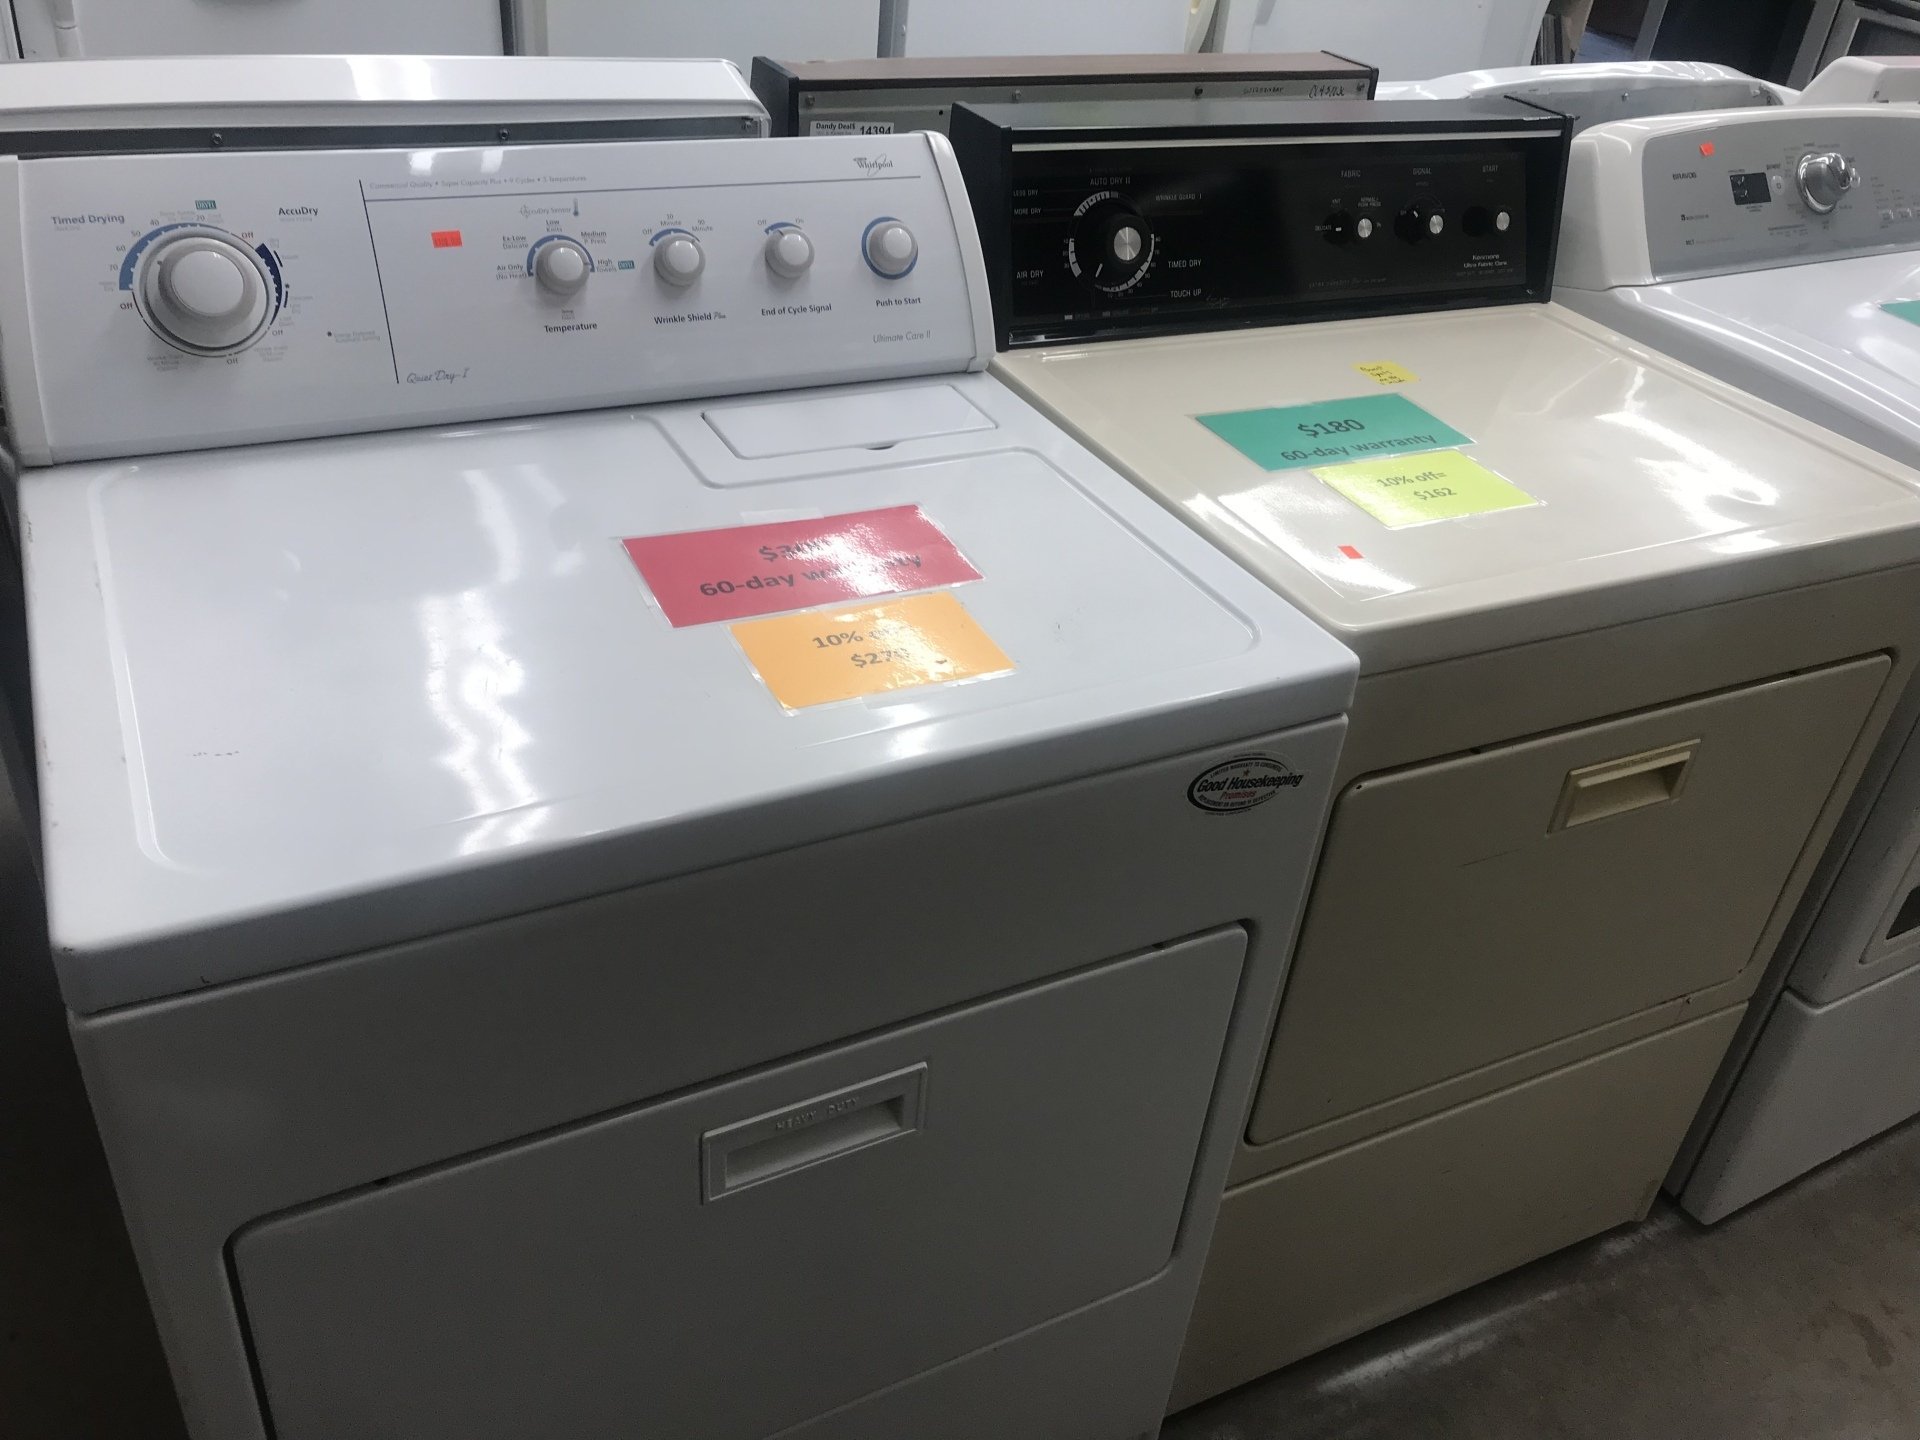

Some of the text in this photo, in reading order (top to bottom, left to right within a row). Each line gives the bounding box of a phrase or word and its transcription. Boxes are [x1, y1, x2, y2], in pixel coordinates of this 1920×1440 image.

[816, 122, 837, 130] Dandy
[859, 126, 891, 135] 14394
[853, 157, 894, 171] Whirlpool
[410, 181, 433, 189] Quality
[461, 178, 488, 187] Capacity
[548, 175, 587, 183] Temperatures
[1089, 178, 1108, 186] AUTO
[1110, 177, 1123, 185] DRY
[278, 206, 319, 217] AccuDry
[1014, 207, 1042, 216] MORE DRY
[51, 214, 125, 225] Timed Drying
[242, 231, 254, 239] Off
[581, 230, 607, 238] Medium
[1472, 253, 1500, 261] Kenmore
[507, 264, 524, 272] Only
[597, 259, 613, 267] High
[1168, 259, 1202, 269] TIMED DRY
[1016, 270, 1044, 279] AIR DRY
[1170, 288, 1202, 298] TOUCH UP
[120, 301, 133, 310] Off
[876, 296, 921, 308] Push to Start
[761, 303, 832, 317] End of Cycle Signal
[654, 312, 685, 325] Wrinkle
[687, 311, 712, 322] Shield
[272, 329, 284, 337] Off
[544, 322, 598, 334] Temperature
[873, 332, 904, 344] Ultimate
[906, 331, 925, 341] Care
[227, 357, 239, 365] Off
[406, 372, 433, 384] Quiet
[1297, 418, 1366, 439] $180
[1280, 433, 1438, 462] 60-day warranty
[1376, 471, 1447, 488] 10% off=
[1413, 487, 1458, 502] $162
[699, 572, 796, 598] 60-day
[812, 630, 864, 649] 10%
[1209, 766, 1230, 779] LIMITED
[1230, 761, 1254, 771] WARRANTY
[1197, 772, 1305, 793] Good Housekeeping
[1219, 790, 1257, 801] Promises
